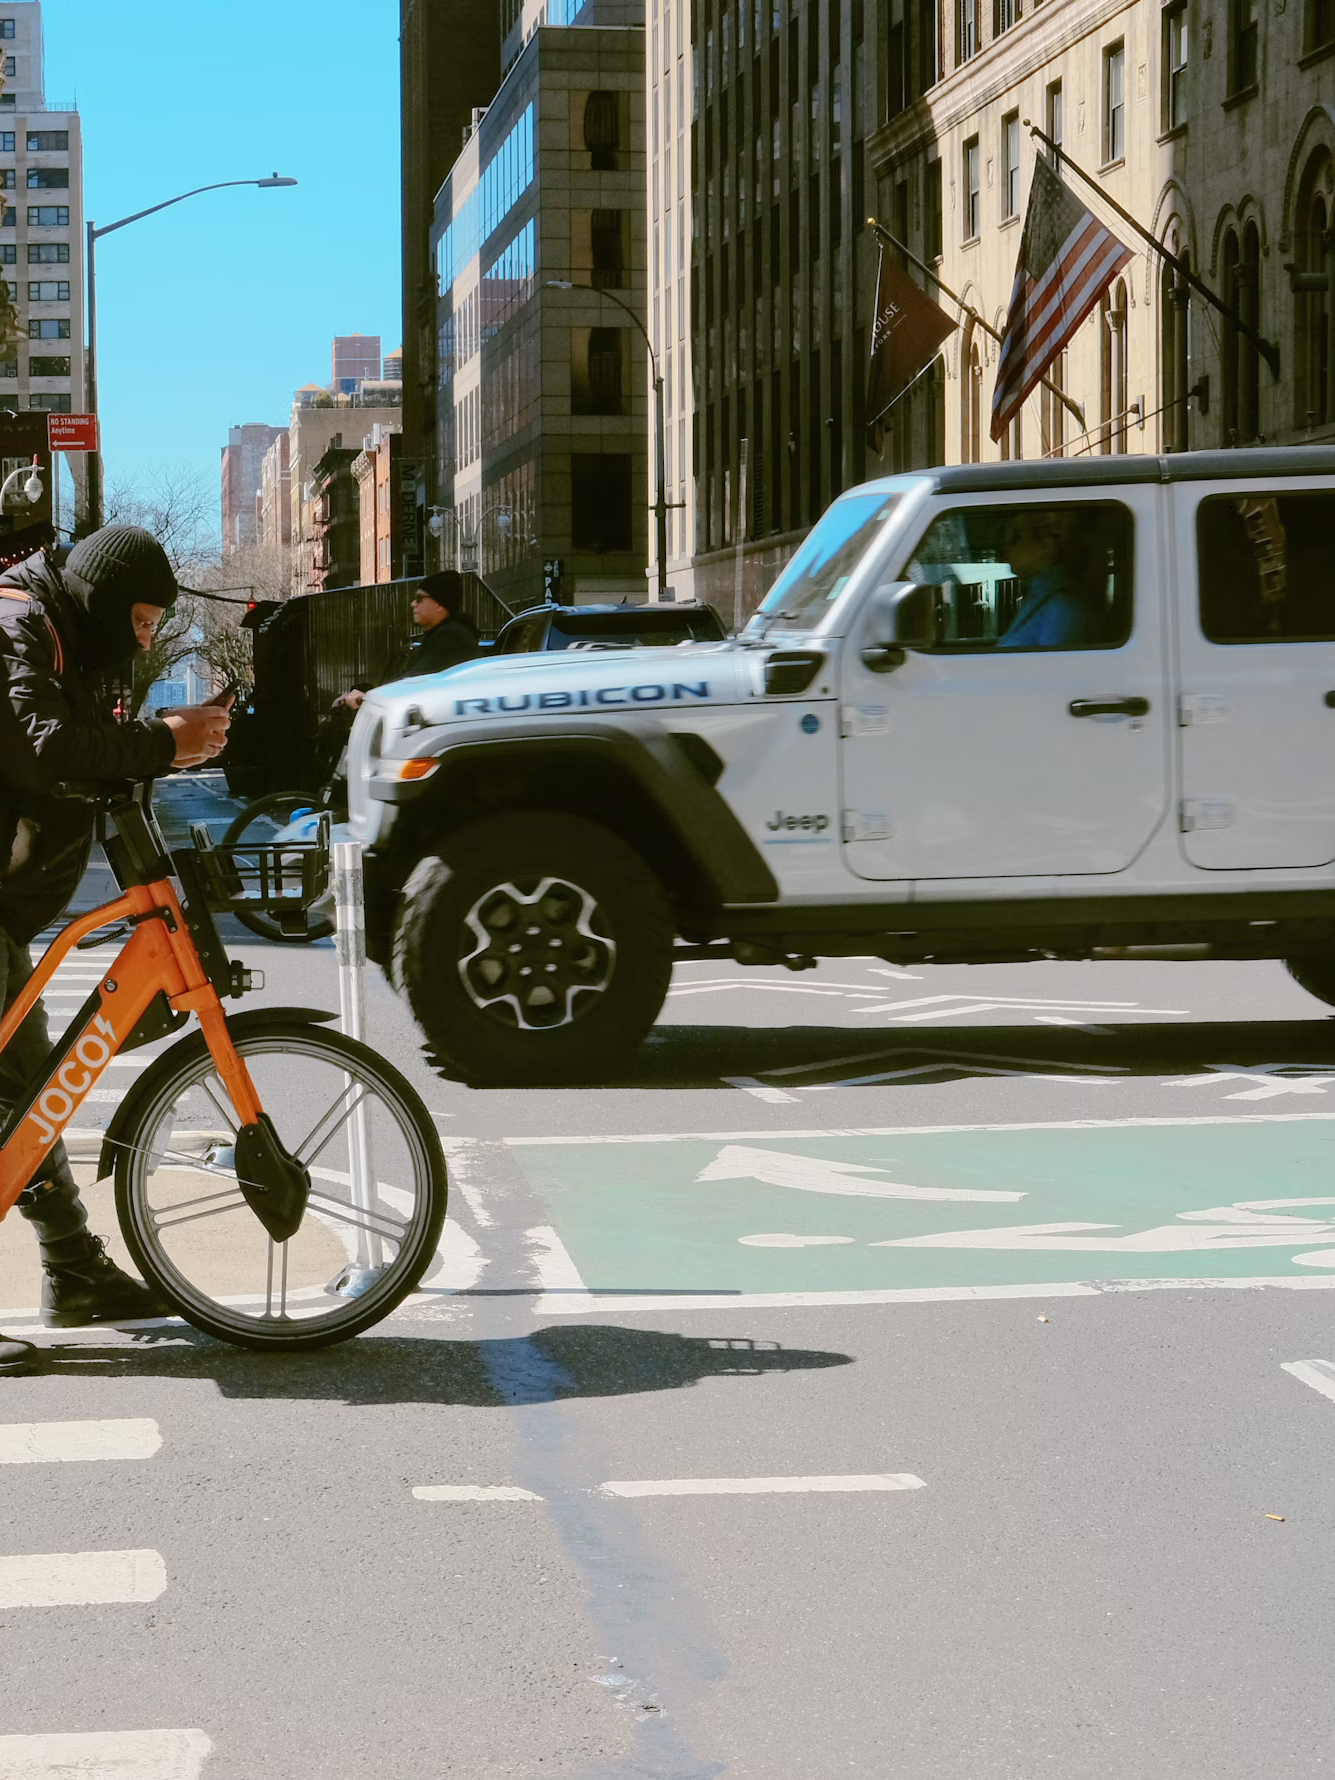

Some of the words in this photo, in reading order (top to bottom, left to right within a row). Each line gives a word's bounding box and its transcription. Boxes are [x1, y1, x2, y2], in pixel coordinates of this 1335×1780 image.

[874, 302, 900, 338] OUSE
[50, 426, 76, 436] Anytime
[453, 679, 710, 716] RUBICON
[767, 810, 830, 834] Jeep
[28, 1033, 110, 1145] JOCO
